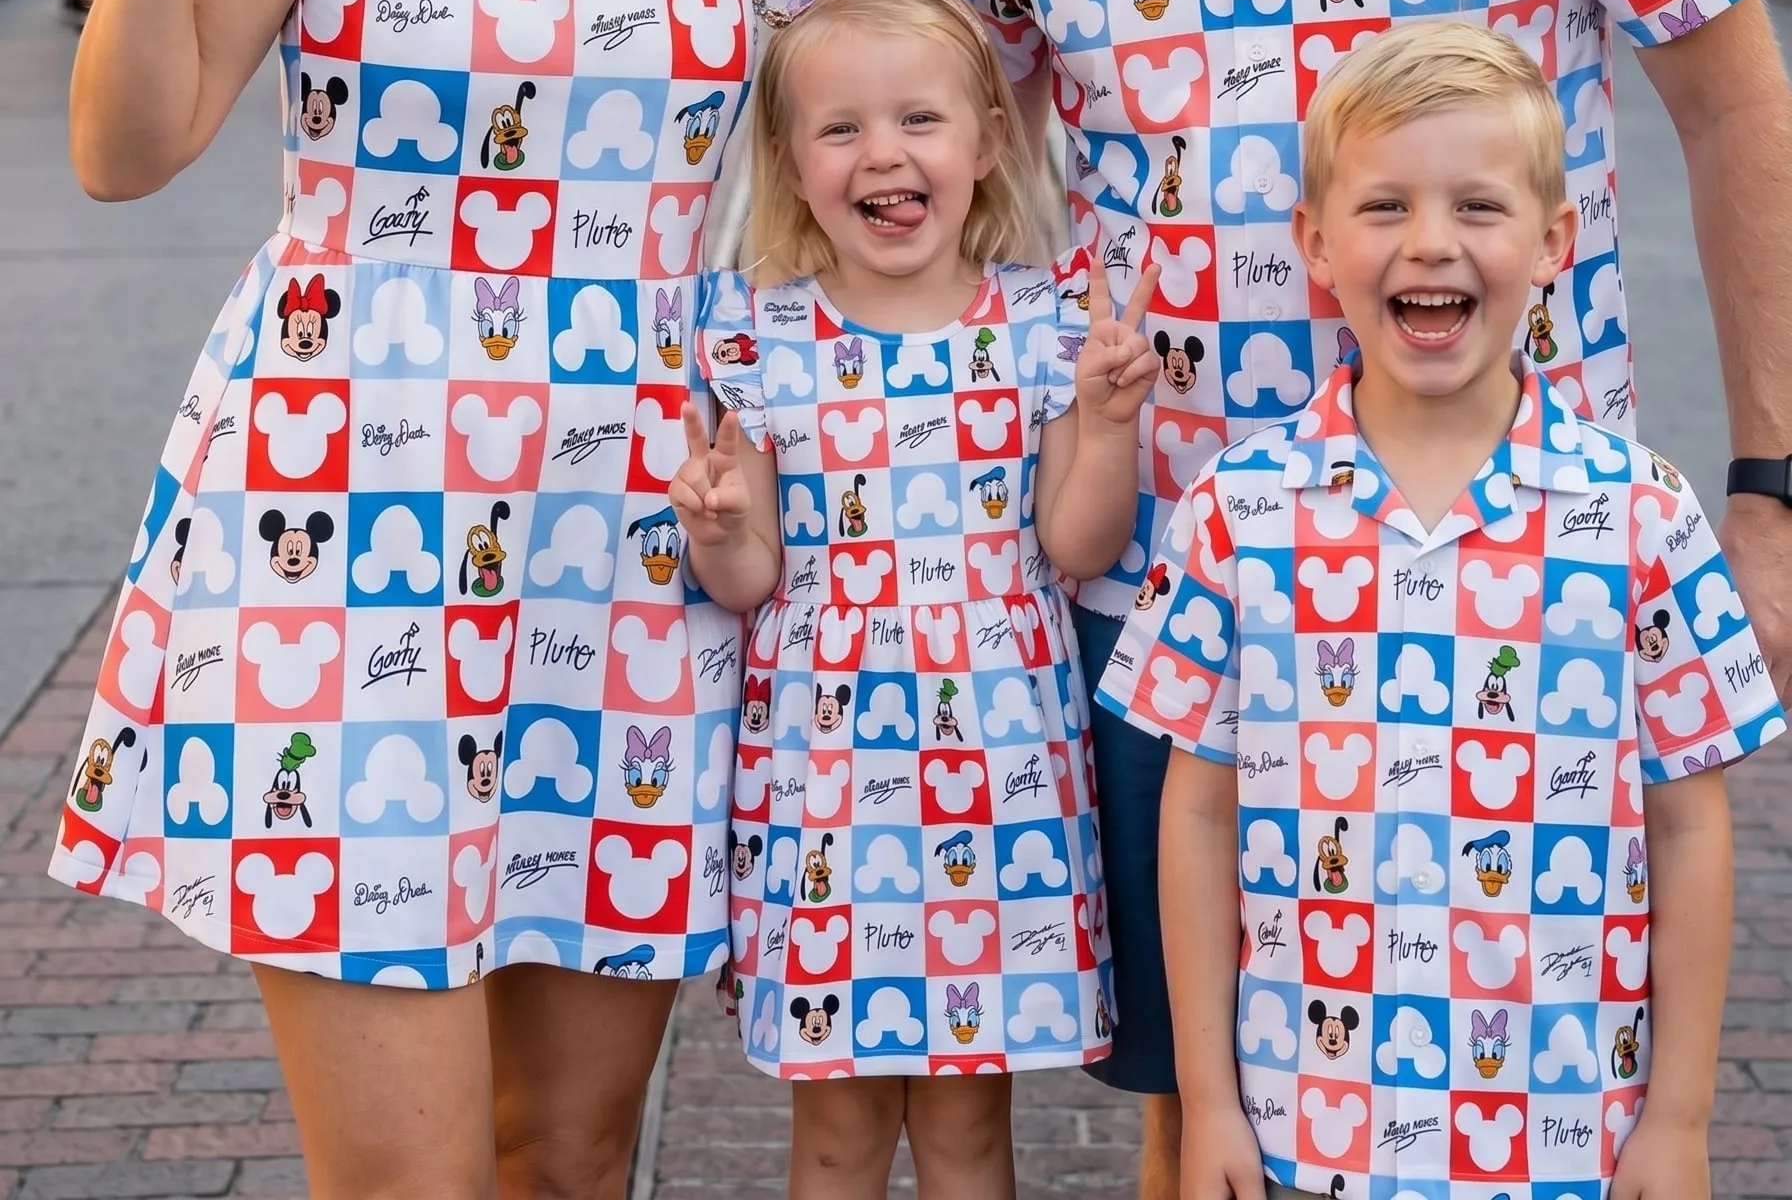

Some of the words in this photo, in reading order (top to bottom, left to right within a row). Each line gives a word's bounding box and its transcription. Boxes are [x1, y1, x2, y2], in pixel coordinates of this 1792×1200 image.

[573, 209, 632, 248] Pluto
[1233, 251, 1291, 288] Pluto
[910, 557, 955, 585] Pluto
[530, 627, 595, 670] Pluto
[872, 618, 904, 645] Pluto
[1724, 650, 1764, 693] Pluto
[865, 923, 914, 952] Pluto
[1388, 929, 1438, 964] Pluto
[1542, 1116, 1592, 1147] Pluto
